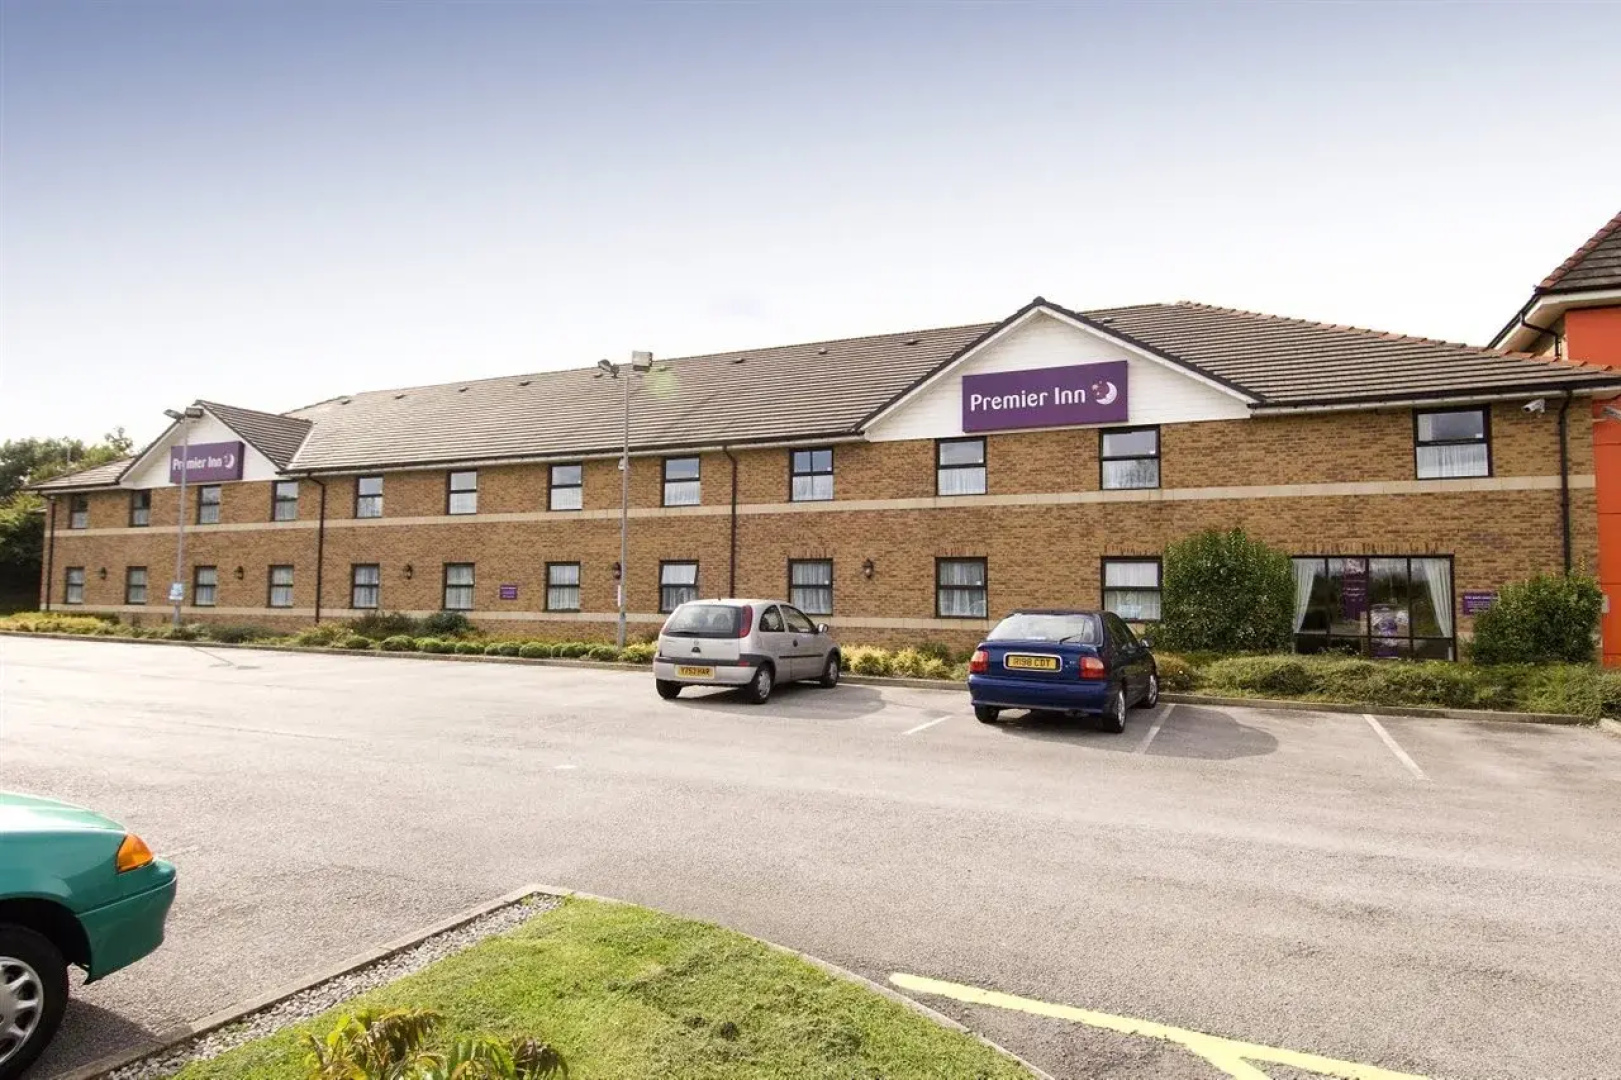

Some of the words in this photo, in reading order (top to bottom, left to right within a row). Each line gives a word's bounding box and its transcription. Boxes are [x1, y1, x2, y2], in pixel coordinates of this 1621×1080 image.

[970, 389, 1049, 412] Premier
[1054, 387, 1086, 405] Inn
[172, 456, 206, 471] Prmier
[208, 456, 222, 468] Inn
